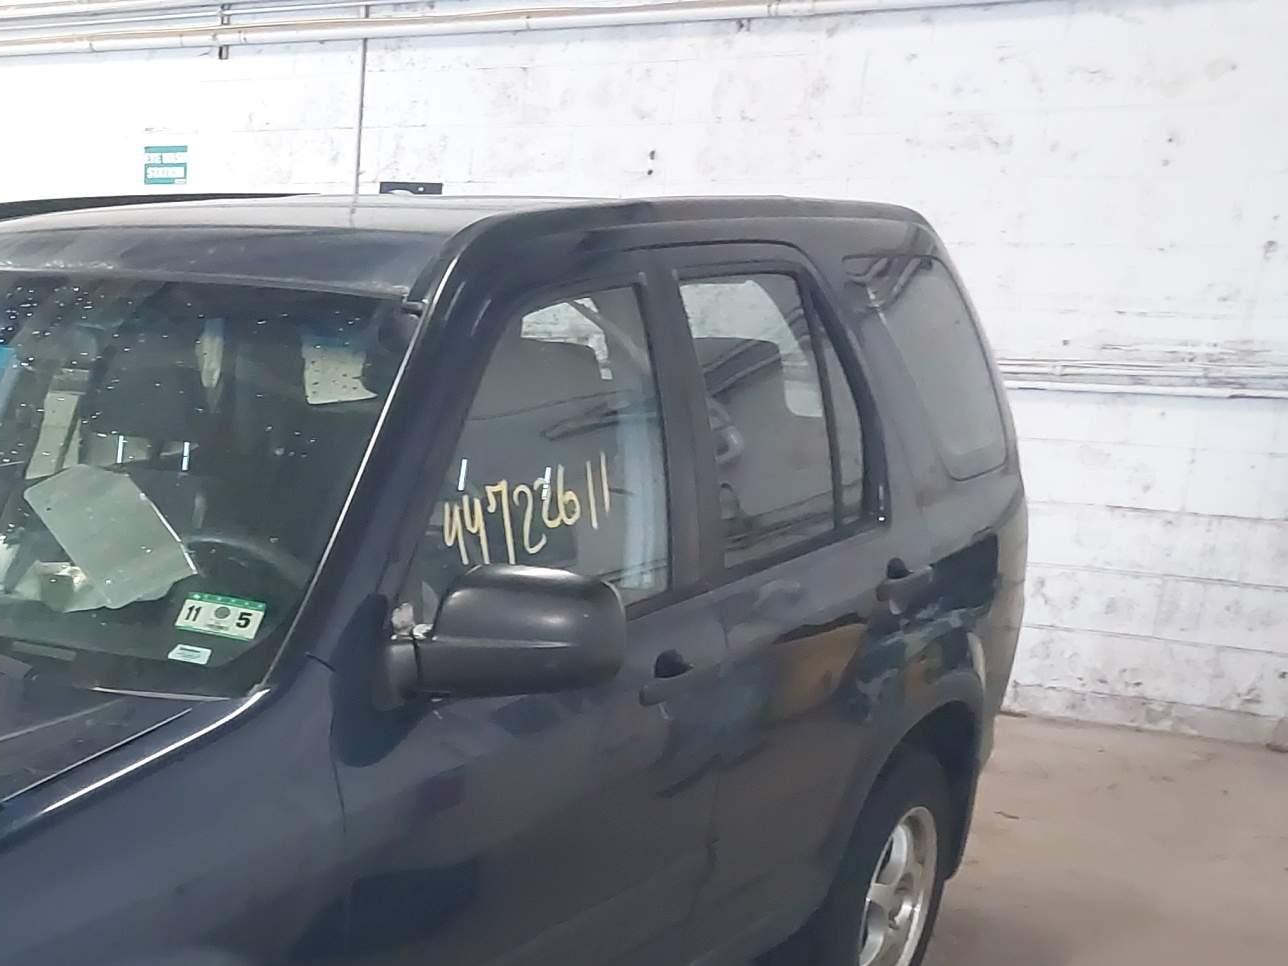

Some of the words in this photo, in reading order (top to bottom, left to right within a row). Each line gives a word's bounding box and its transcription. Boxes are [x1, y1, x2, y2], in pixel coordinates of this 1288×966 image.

[443, 451, 611, 565] 44722611
[185, 605, 202, 622] 11
[236, 612, 253, 628] 5
